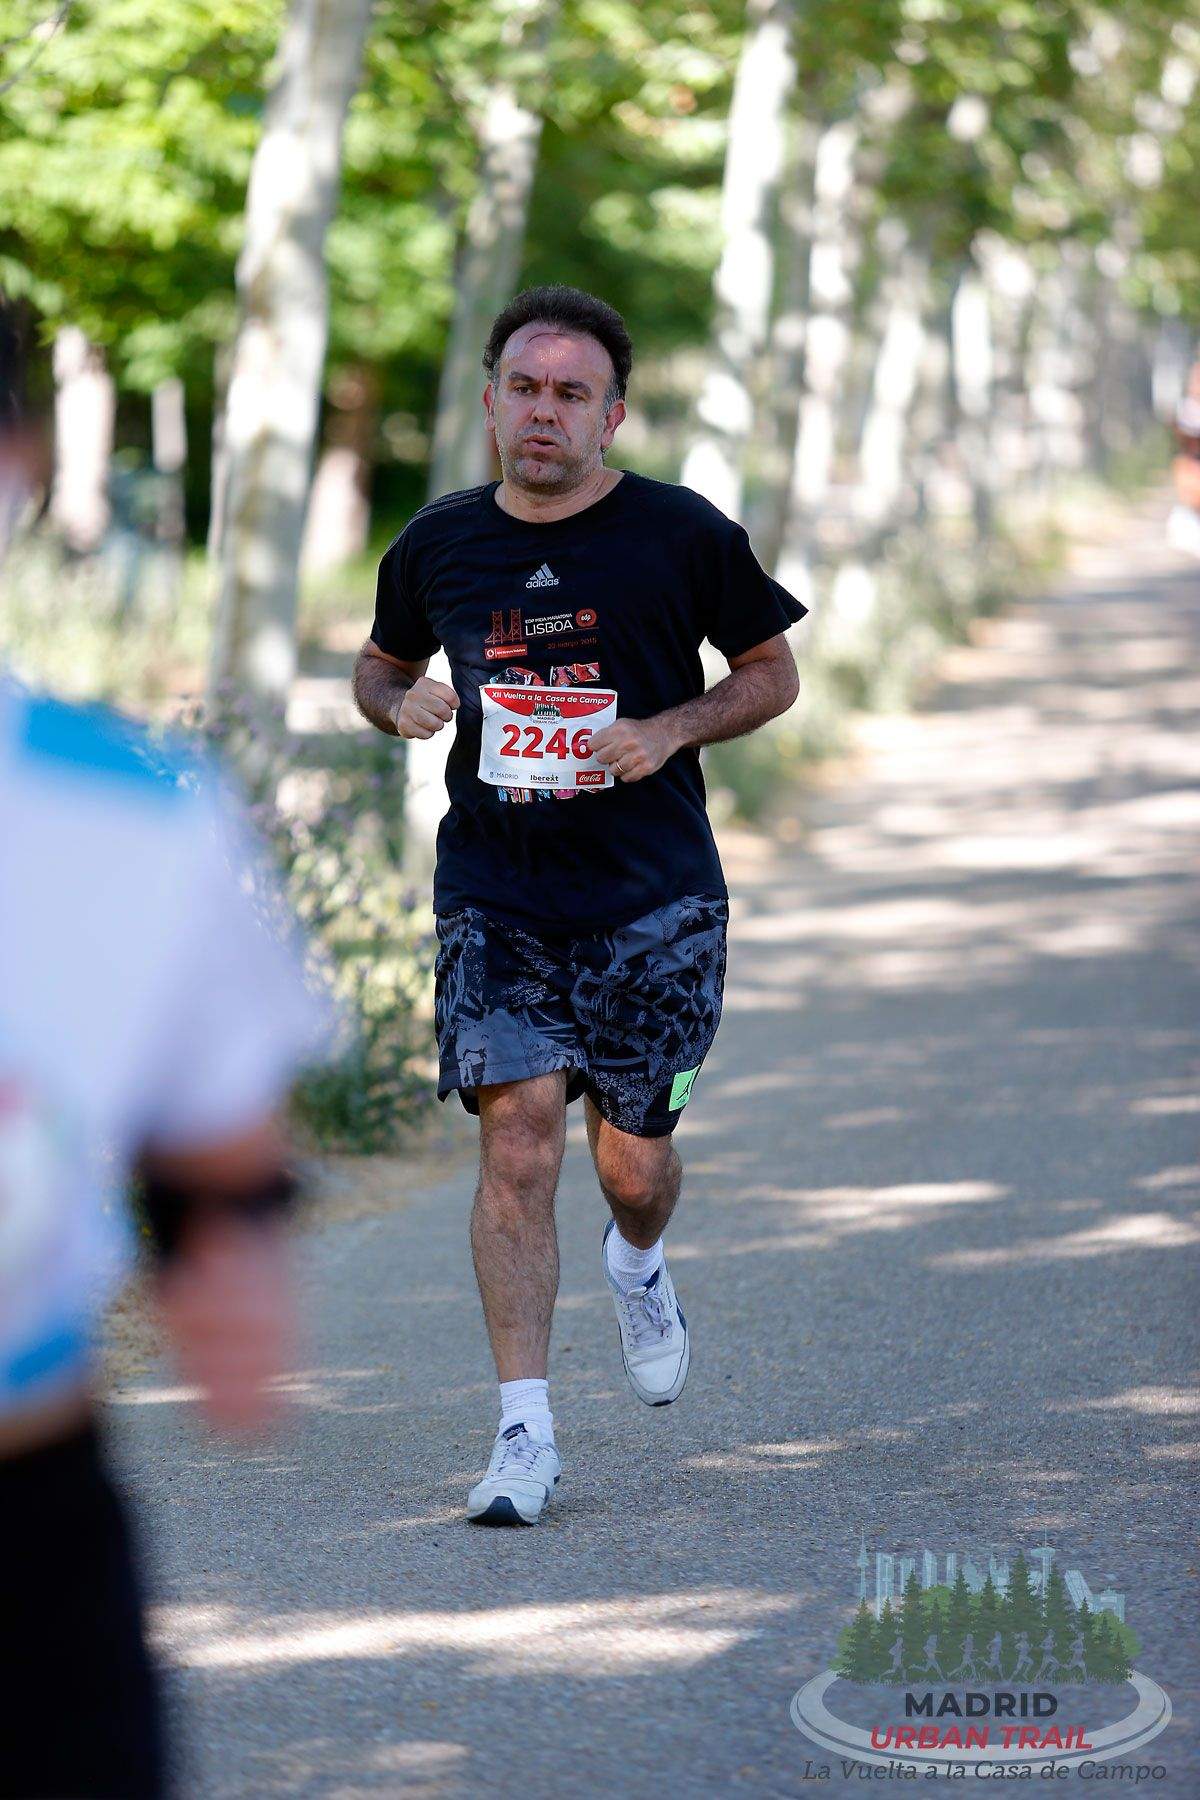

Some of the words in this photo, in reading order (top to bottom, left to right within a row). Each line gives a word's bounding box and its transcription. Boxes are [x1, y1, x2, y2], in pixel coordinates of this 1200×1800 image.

[525, 577, 559, 589] adidas
[525, 619, 574, 636] LISBOA
[503, 692, 526, 700] Vuelta
[579, 696, 609, 705] Campo
[500, 724, 594, 760] 2246
[496, 772, 519, 780] MADRID
